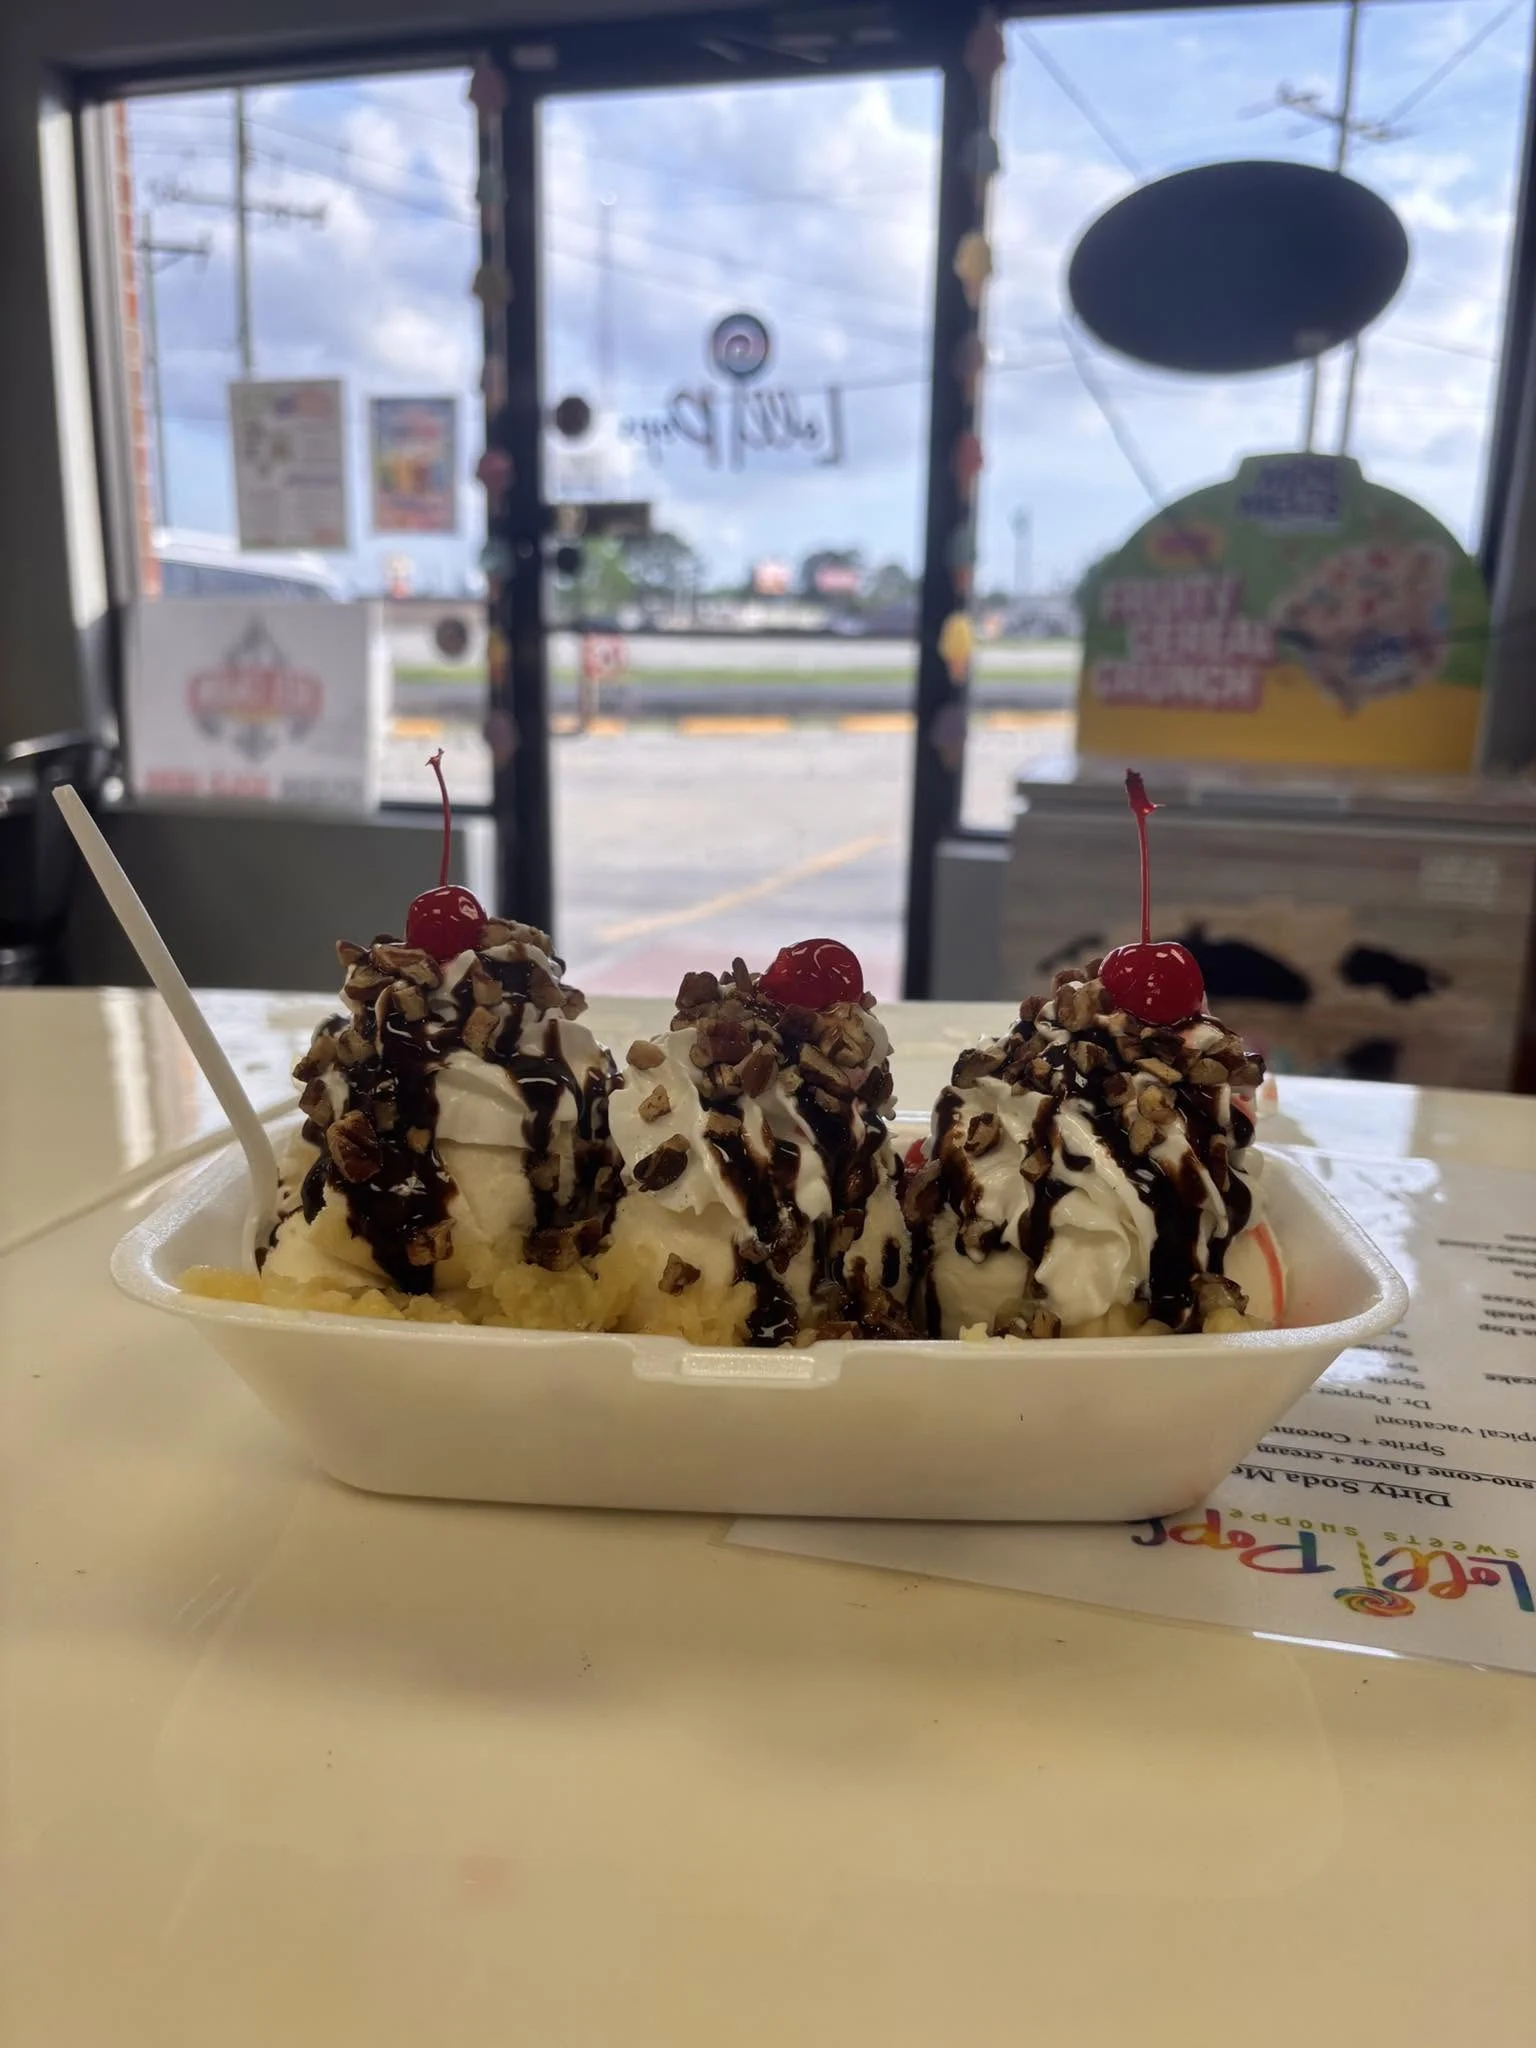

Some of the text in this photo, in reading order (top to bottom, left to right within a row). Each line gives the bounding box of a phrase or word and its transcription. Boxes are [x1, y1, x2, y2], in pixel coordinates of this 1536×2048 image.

[1099, 574, 1240, 624] FRUITY
[1129, 620, 1275, 662] CEREAL
[1091, 659, 1254, 702] CRUNCH
[1484, 1308, 1536, 1322] plash
[1318, 1387, 1433, 1410] Dr. Pepper
[1374, 1414, 1474, 1434] vacation!
[1359, 1437, 1375, 1445] +
[1378, 1438, 1446, 1457] Sprite
[1256, 1444, 1535, 1490] sno-cone flavor + cream
[1231, 1465, 1453, 1508] Dirty Soda Me
